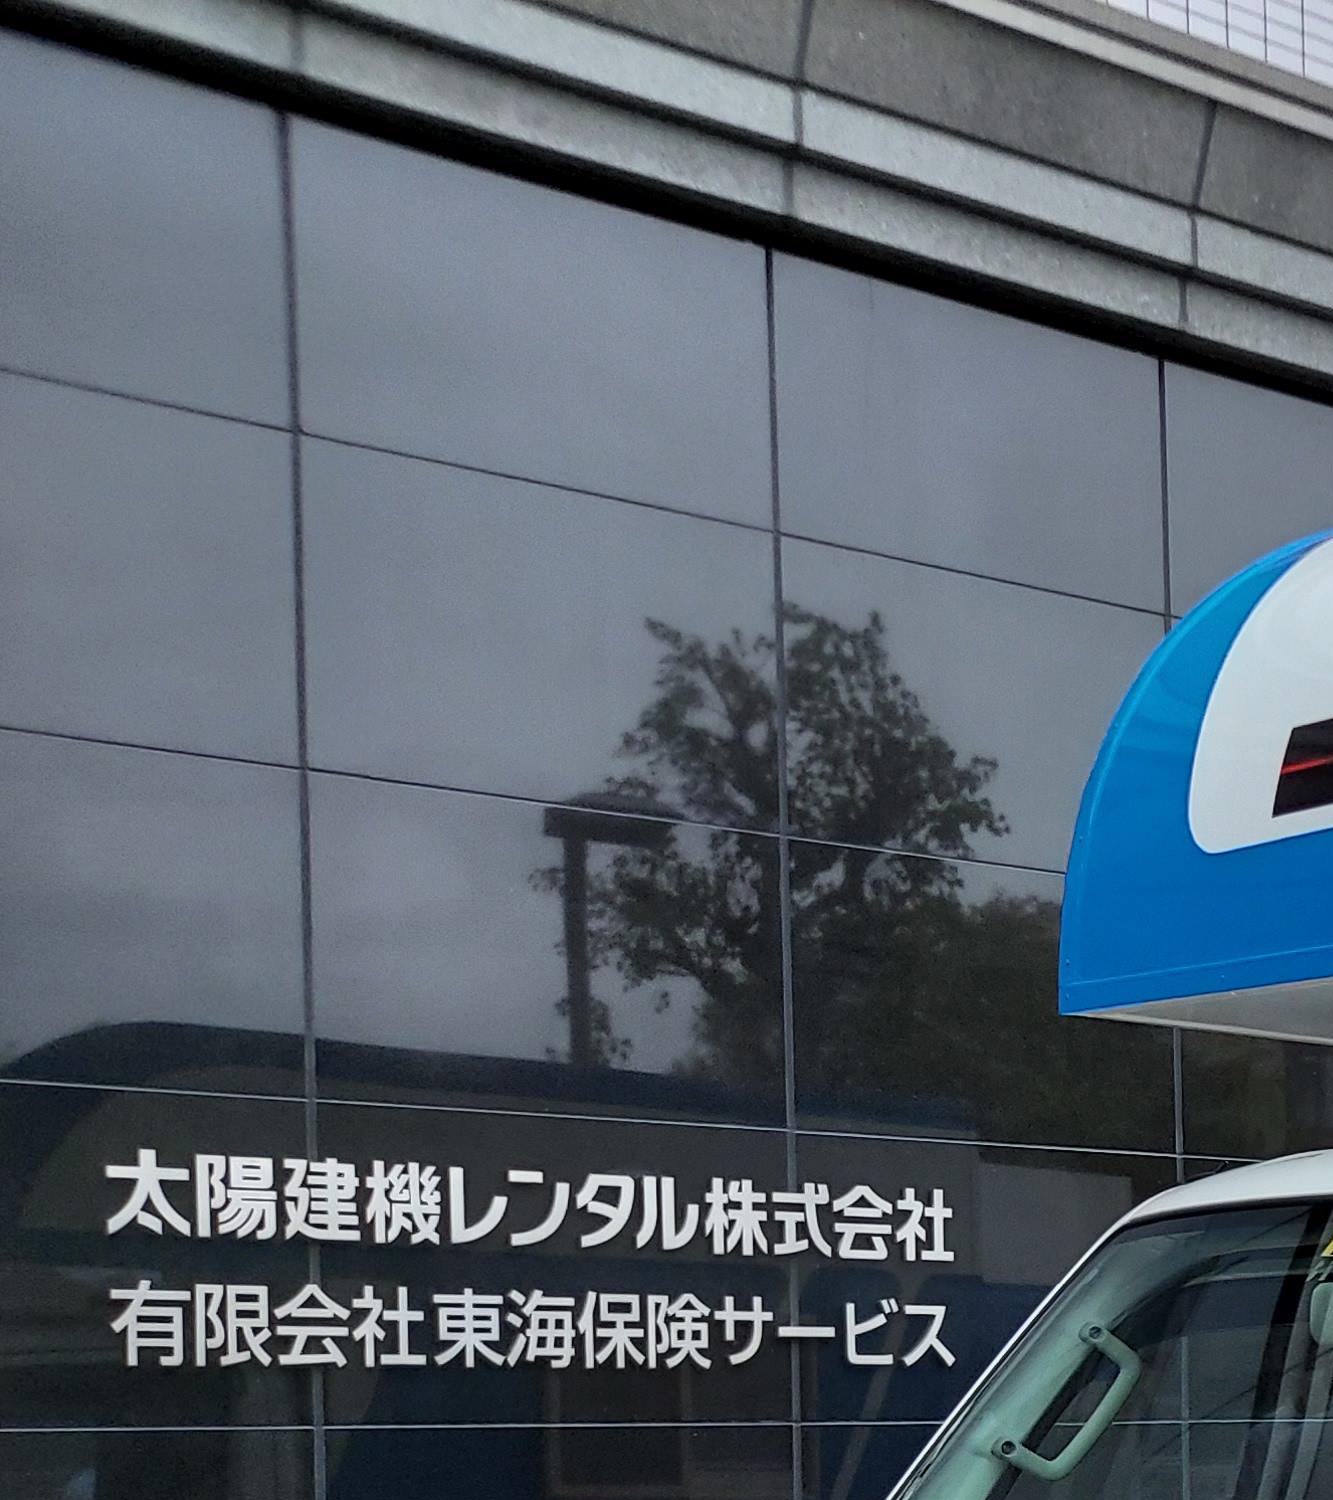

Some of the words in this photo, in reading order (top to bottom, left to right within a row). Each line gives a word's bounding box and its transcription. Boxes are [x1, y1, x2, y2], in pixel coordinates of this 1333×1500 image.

[105, 1148, 955, 1263] 太陽建機レンタル株式会社
[110, 1280, 955, 1368] 有限会社東海保険サービス
